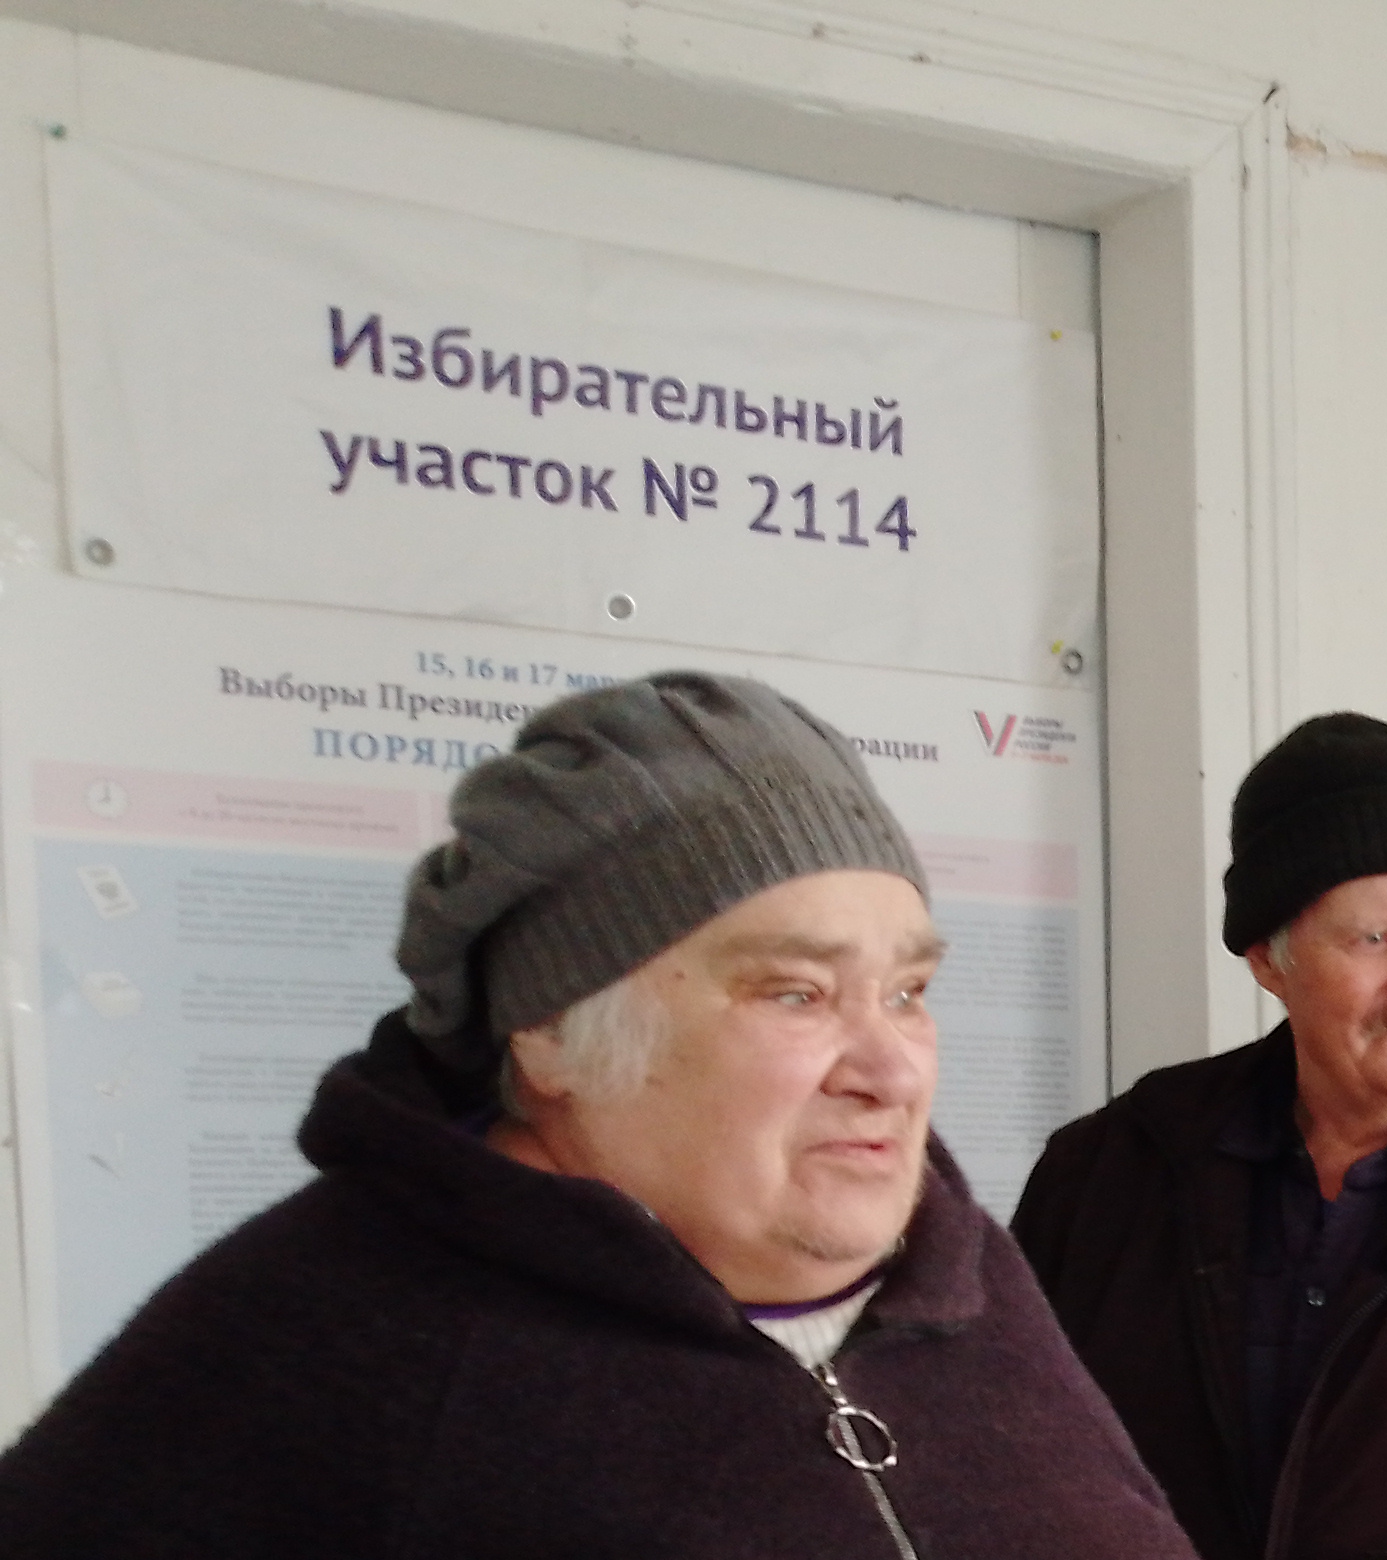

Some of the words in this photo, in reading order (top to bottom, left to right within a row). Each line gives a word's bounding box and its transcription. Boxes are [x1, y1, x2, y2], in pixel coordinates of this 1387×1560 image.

[328, 306, 903, 457] Избирательный
[320, 429, 619, 513] участок
[641, 457, 719, 523] №
[747, 474, 917, 552] 2114
[219, 666, 367, 713] Выборы
[377, 682, 540, 722] Президе
[416, 651, 454, 679] 15,
[465, 656, 494, 679] 16
[502, 666, 518, 683] и
[529, 662, 558, 687] 17
[565, 671, 616, 689] мар
[313, 726, 502, 773] ПОРЯДО
[850, 736, 939, 761] рации
